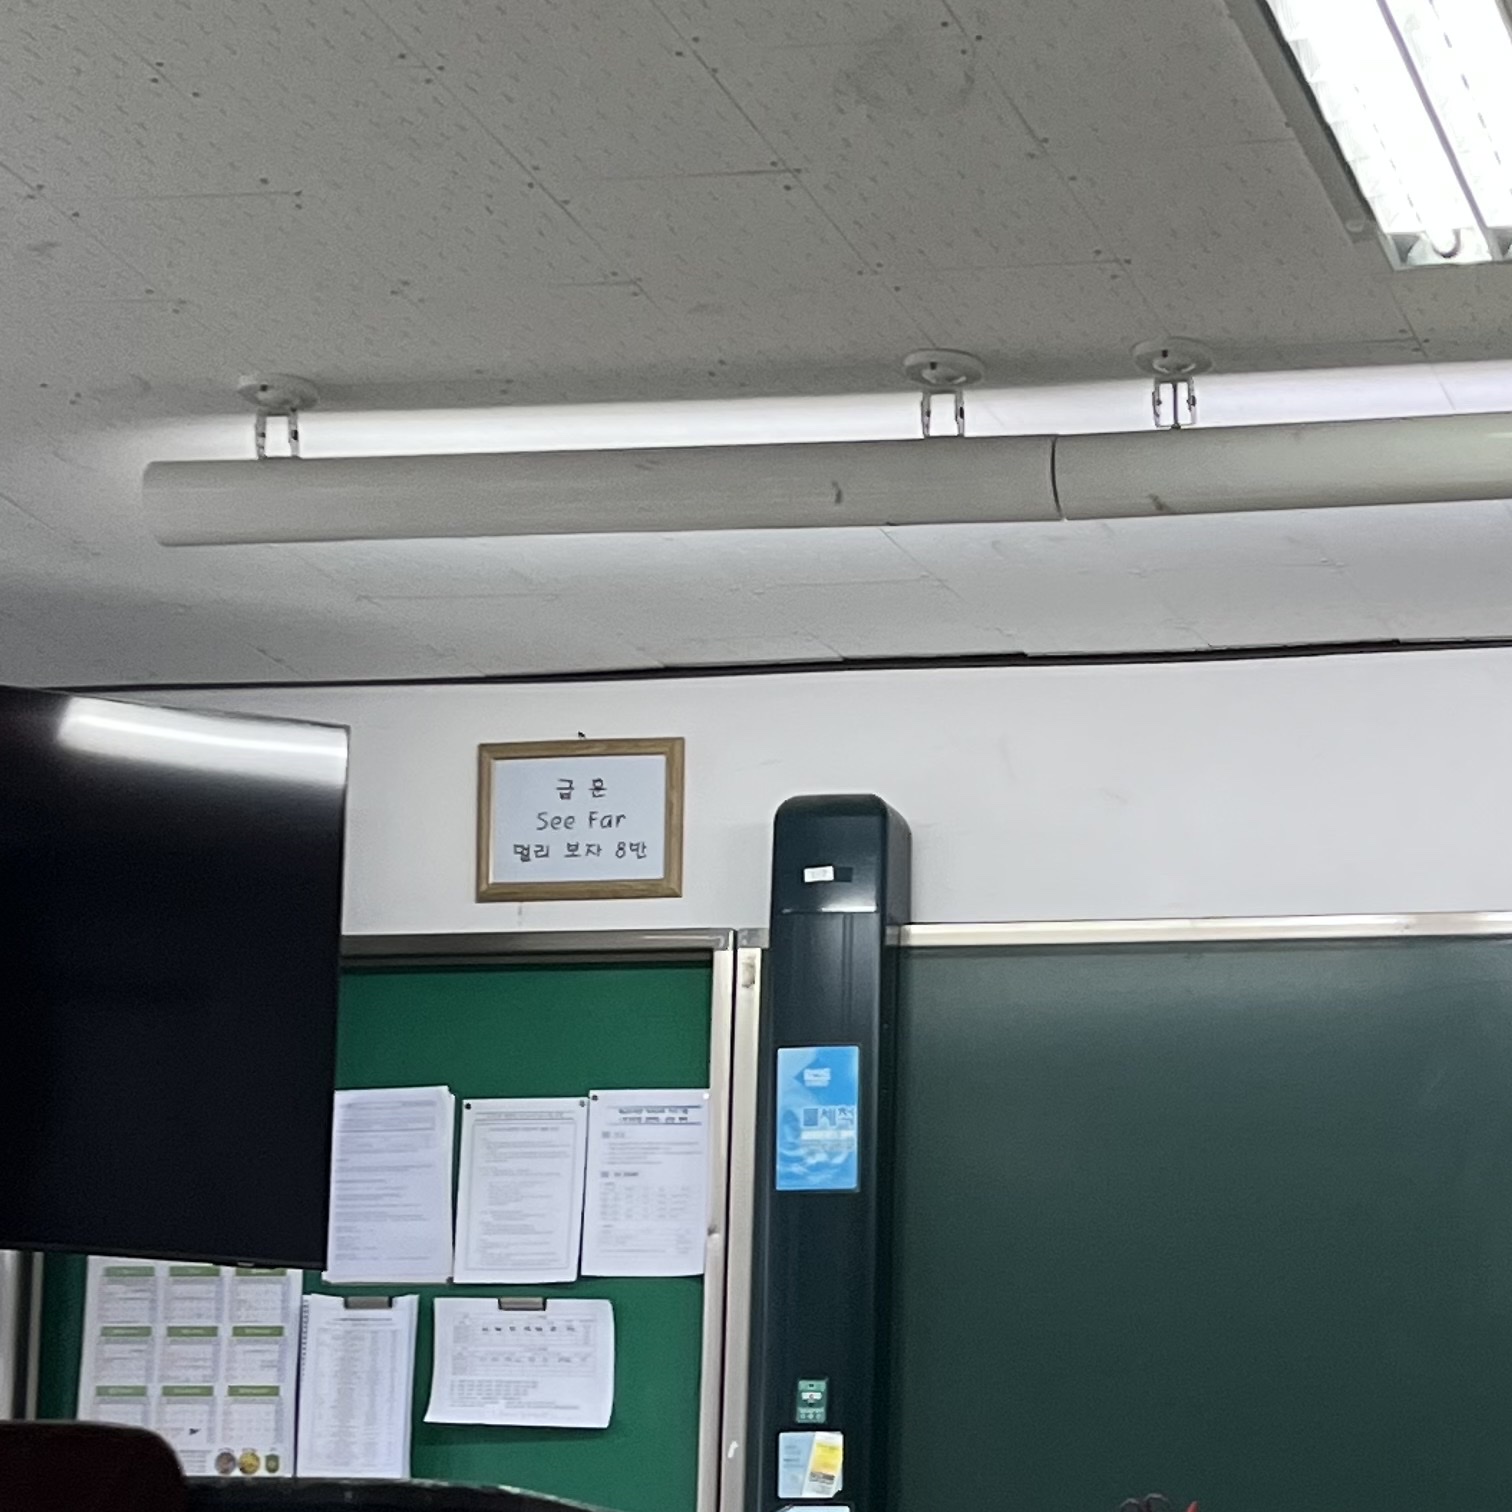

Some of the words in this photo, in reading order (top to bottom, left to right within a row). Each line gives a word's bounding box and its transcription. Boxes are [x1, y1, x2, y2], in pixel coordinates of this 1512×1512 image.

[536, 811, 576, 831] See
[588, 811, 627, 829] Far
[513, 843, 550, 863] 멀리
[564, 841, 603, 858] 보자
[615, 841, 648, 860] 8반
